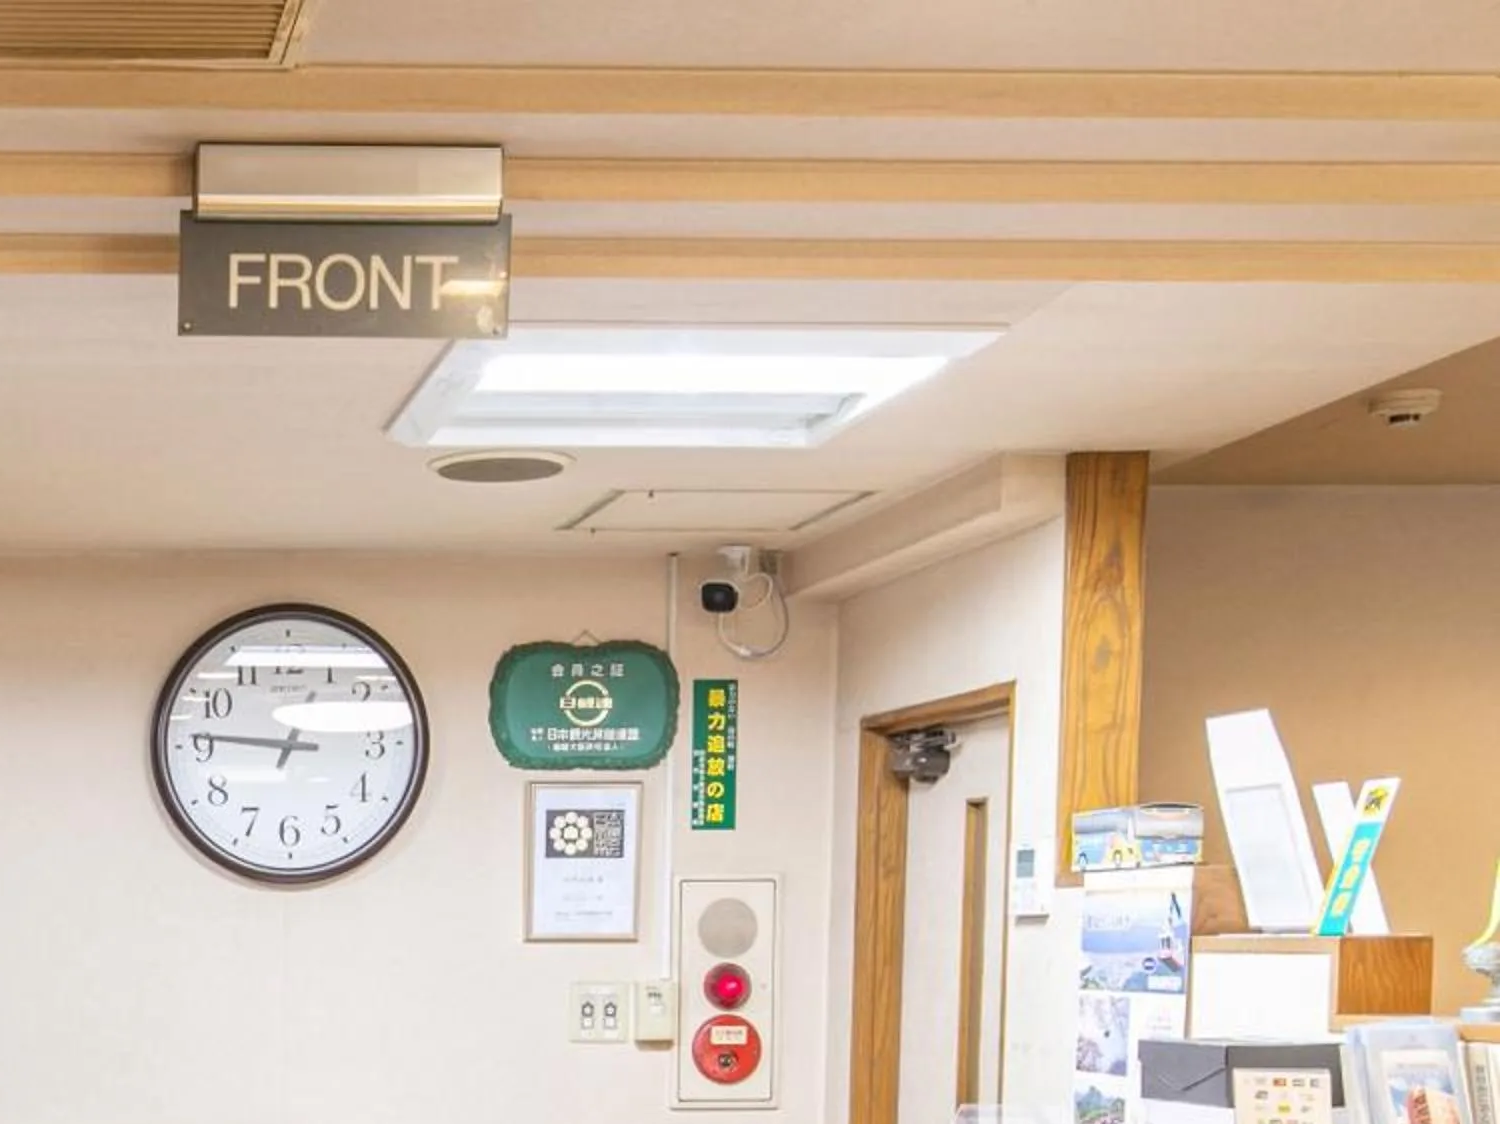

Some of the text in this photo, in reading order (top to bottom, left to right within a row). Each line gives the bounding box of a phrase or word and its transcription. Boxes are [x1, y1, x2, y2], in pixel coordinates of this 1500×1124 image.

[228, 253, 459, 311] FRONT
[204, 688, 233, 719] 10
[192, 733, 214, 762] 9
[364, 729, 385, 760] 3
[207, 774, 229, 806] 8
[350, 772, 373, 803] 4
[241, 806, 261, 837] 7
[278, 815, 301, 847] 6
[320, 804, 342, 836] 5
